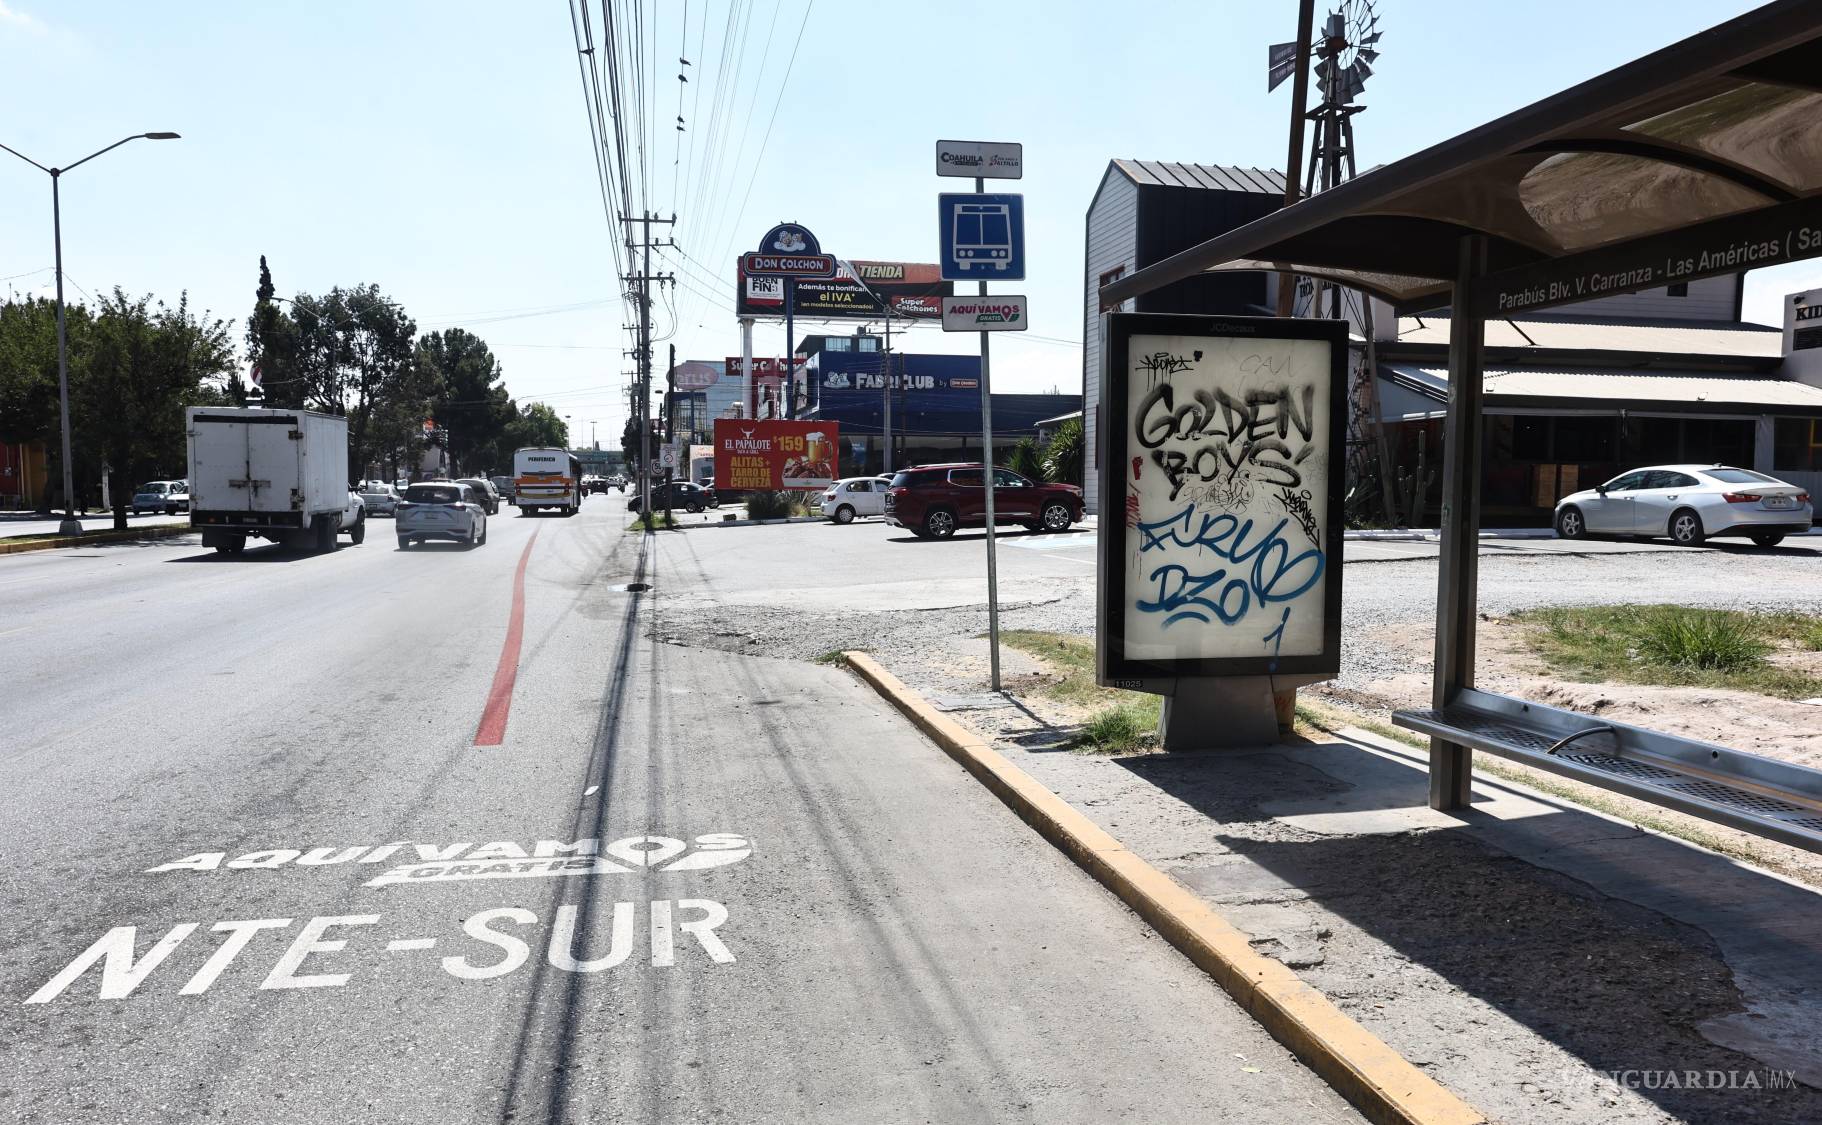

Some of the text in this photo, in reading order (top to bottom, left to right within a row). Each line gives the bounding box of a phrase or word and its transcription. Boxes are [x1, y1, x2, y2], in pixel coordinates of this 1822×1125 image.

[941, 152, 983, 162] COAHUILA
[754, 258, 824, 270] DON COLCHON
[860, 265, 903, 278] TIENDA
[1499, 286, 1545, 310] Parabús
[1550, 282, 1571, 300] Blv.
[1575, 277, 1586, 295] V.
[1591, 267, 1652, 292] Carranza
[1667, 258, 1694, 278] Las
[1698, 240, 1779, 272] Américas
[820, 293, 830, 301] el
[725, 440, 771, 449] EL PAPALOTE
[773, 435, 804, 452] $159
[730, 457, 764, 467] ALITAS
[730, 467, 771, 477] TARRO DE
[730, 477, 771, 488] CERVEZA
[407, 858, 597, 879] GRATIS
